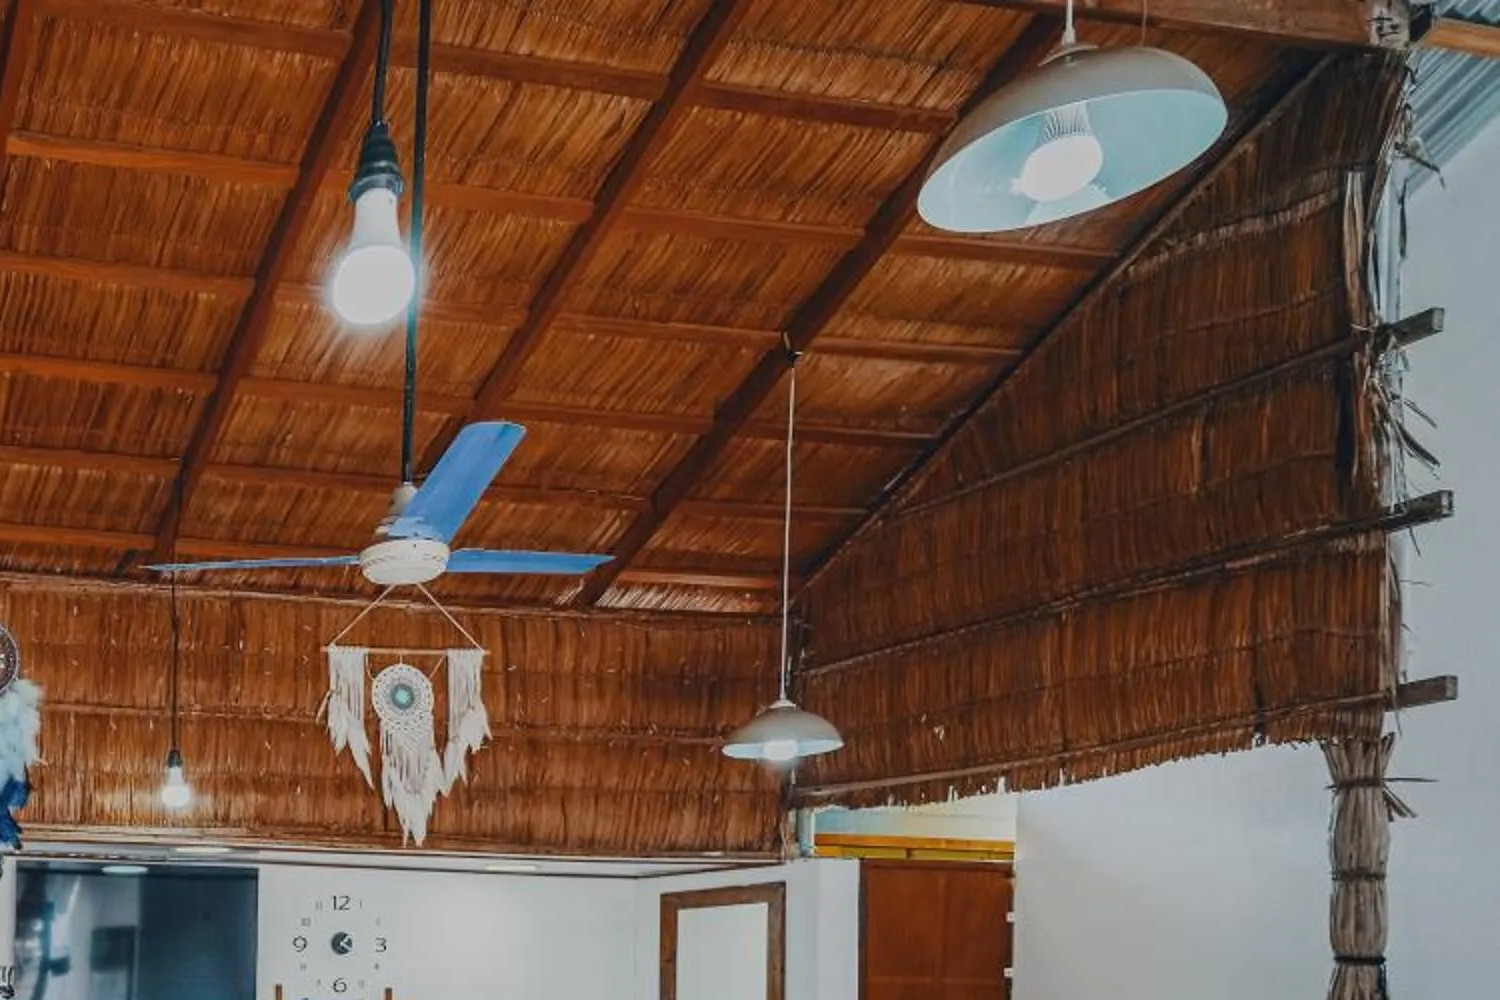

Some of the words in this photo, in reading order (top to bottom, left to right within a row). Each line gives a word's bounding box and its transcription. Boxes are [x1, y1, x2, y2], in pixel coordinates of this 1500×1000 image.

[333, 895, 351, 911] 12
[292, 935, 307, 953] 9
[375, 937, 388, 953] 3
[332, 977, 348, 993] 6
